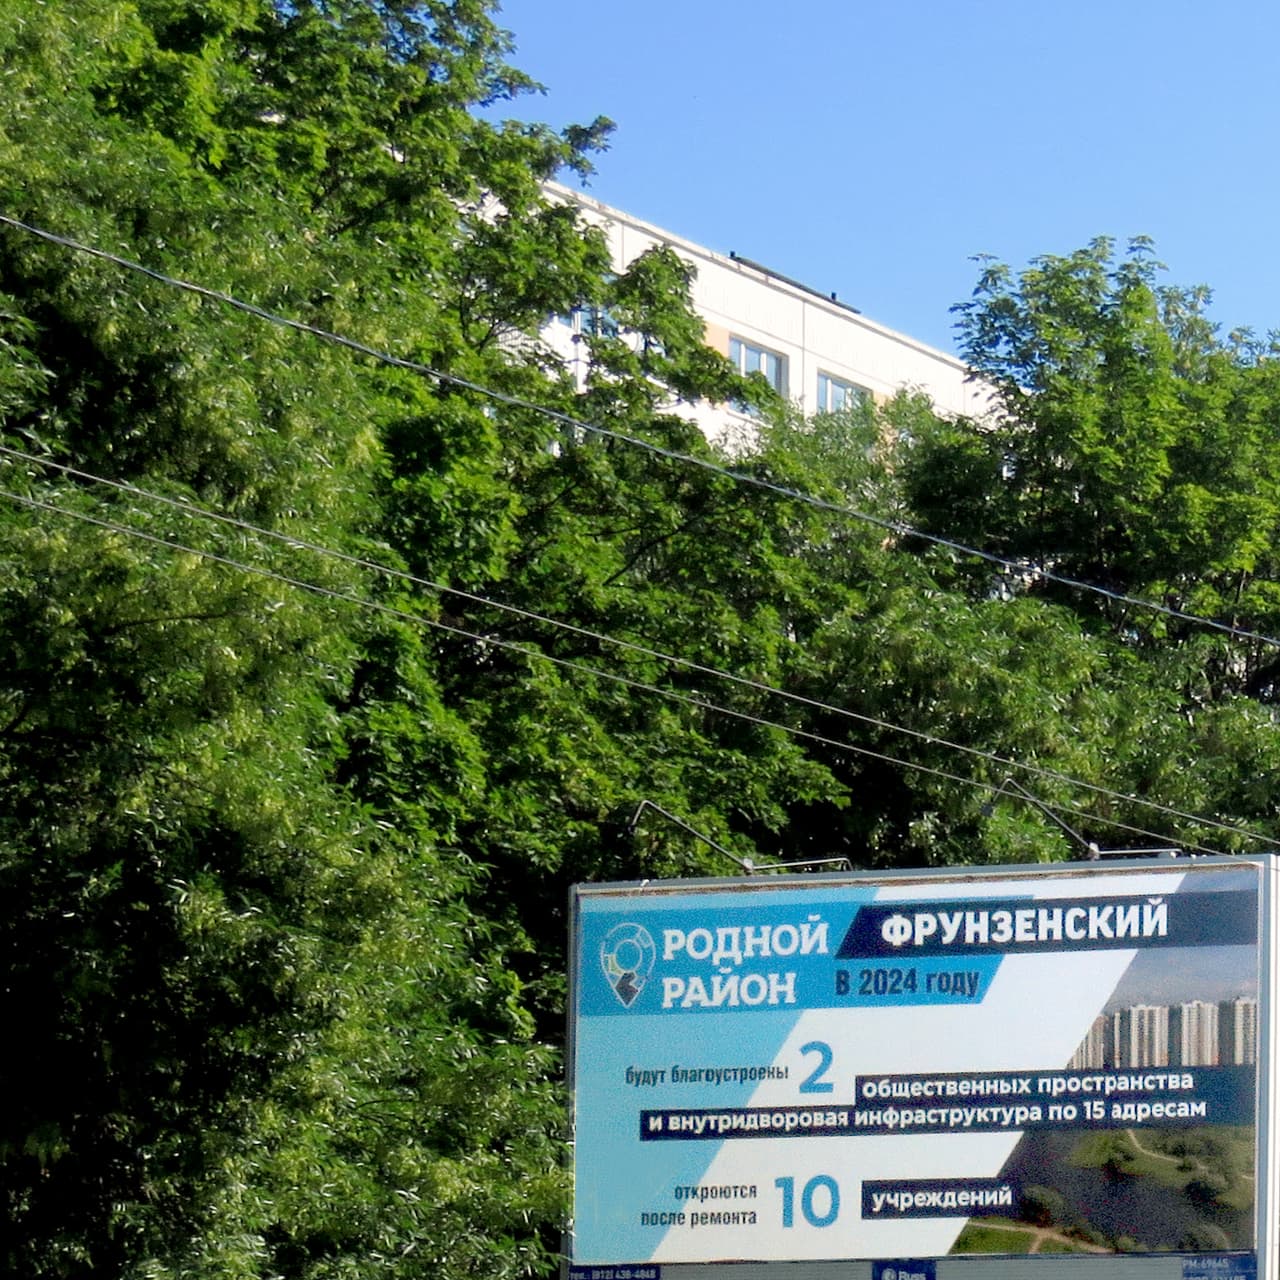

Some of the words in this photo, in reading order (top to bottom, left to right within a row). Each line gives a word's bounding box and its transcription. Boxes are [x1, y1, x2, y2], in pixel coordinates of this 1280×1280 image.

[882, 898, 1168, 946] ФРУНЗЕНСКИЙ
[662, 914, 829, 966] РОДНОЙ
[662, 967, 797, 1009] РАЙОН
[859, 967, 918, 996] 2024
[926, 970, 979, 998] году
[625, 1065, 666, 1087] будут
[671, 1063, 789, 1085] благоустроены
[799, 1040, 834, 1094] 2
[862, 1077, 1031, 1098] общественных
[1038, 1072, 1194, 1097] пространства
[649, 1115, 662, 1131] и
[668, 1110, 848, 1134] внутридворовая
[855, 1104, 1042, 1127] инфраструктура
[1048, 1103, 1077, 1121] по
[1083, 1101, 1105, 1119] 15
[1111, 1099, 1206, 1122] адресам
[674, 1184, 757, 1202] откроются
[774, 1173, 840, 1229] 10
[872, 1185, 1013, 1212] учреждений
[641, 1211, 686, 1227] после
[691, 1210, 757, 1227] ремонта
